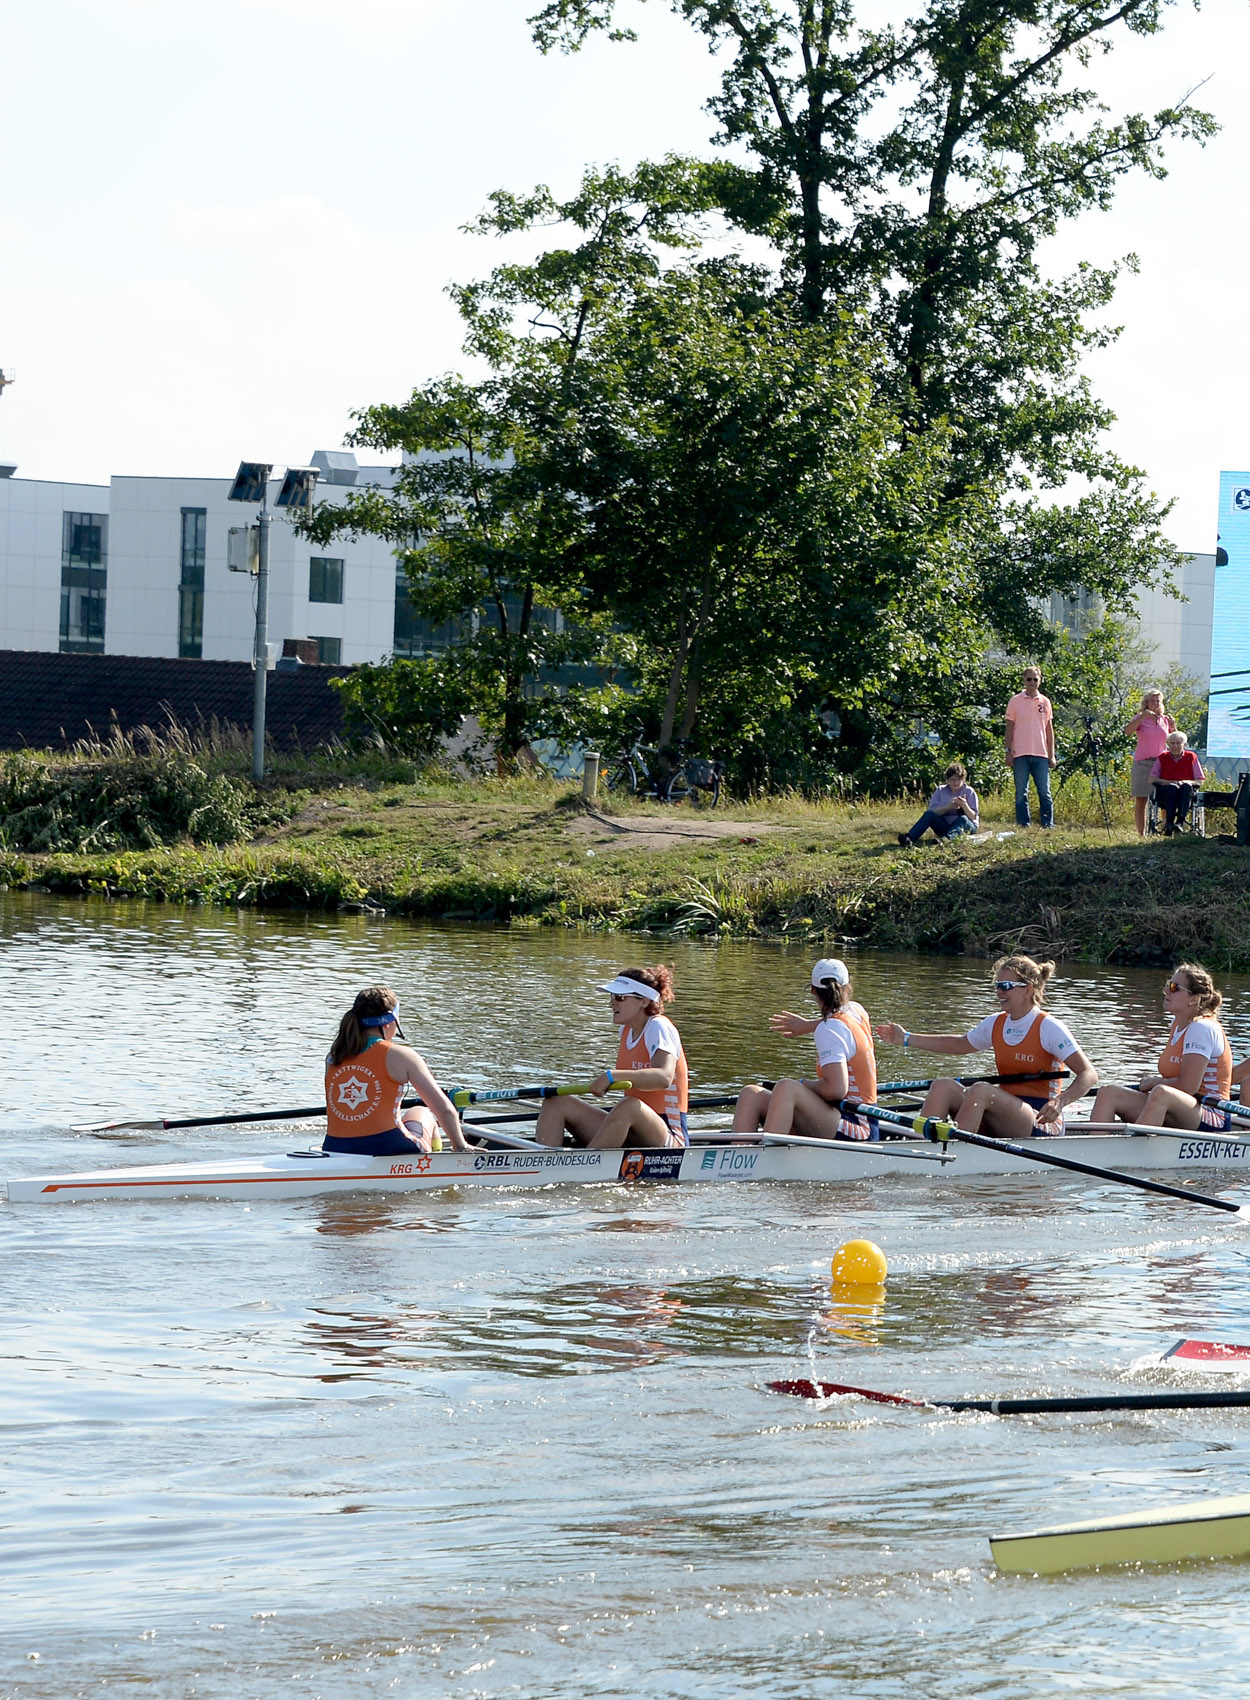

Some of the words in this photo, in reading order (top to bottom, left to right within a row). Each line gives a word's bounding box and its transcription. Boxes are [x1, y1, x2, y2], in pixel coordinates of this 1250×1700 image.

[1192, 1043, 1206, 1051] Flow
[1015, 1053, 1034, 1062] KRG
[335, 1065, 373, 1078] KETTWIGER
[487, 1155, 511, 1167] RBL
[513, 1155, 601, 1168] RUDER-BUNDESLIGA
[644, 1156, 683, 1165] RUHR-ACHTER
[720, 1151, 758, 1170] Flow
[390, 1164, 413, 1175] KRG
